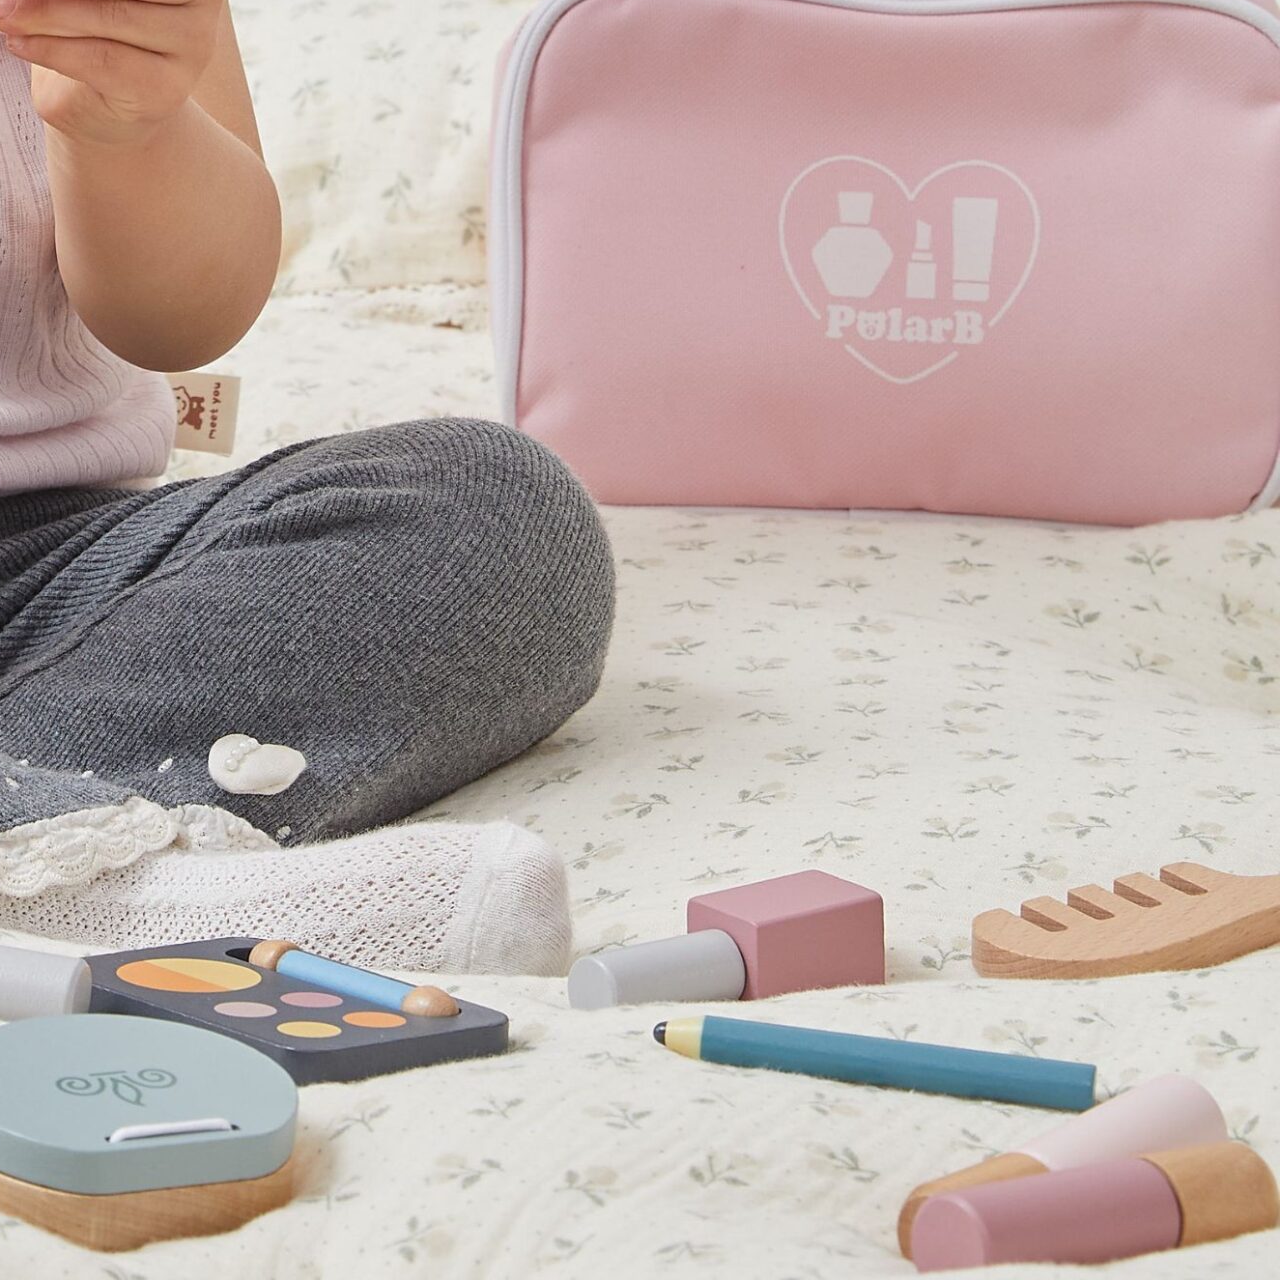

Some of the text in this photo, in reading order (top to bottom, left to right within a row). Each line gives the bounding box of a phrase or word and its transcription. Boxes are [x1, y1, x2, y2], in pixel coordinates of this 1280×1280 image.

[825, 304, 985, 345] PolarB
[208, 381, 222, 440] meet you
